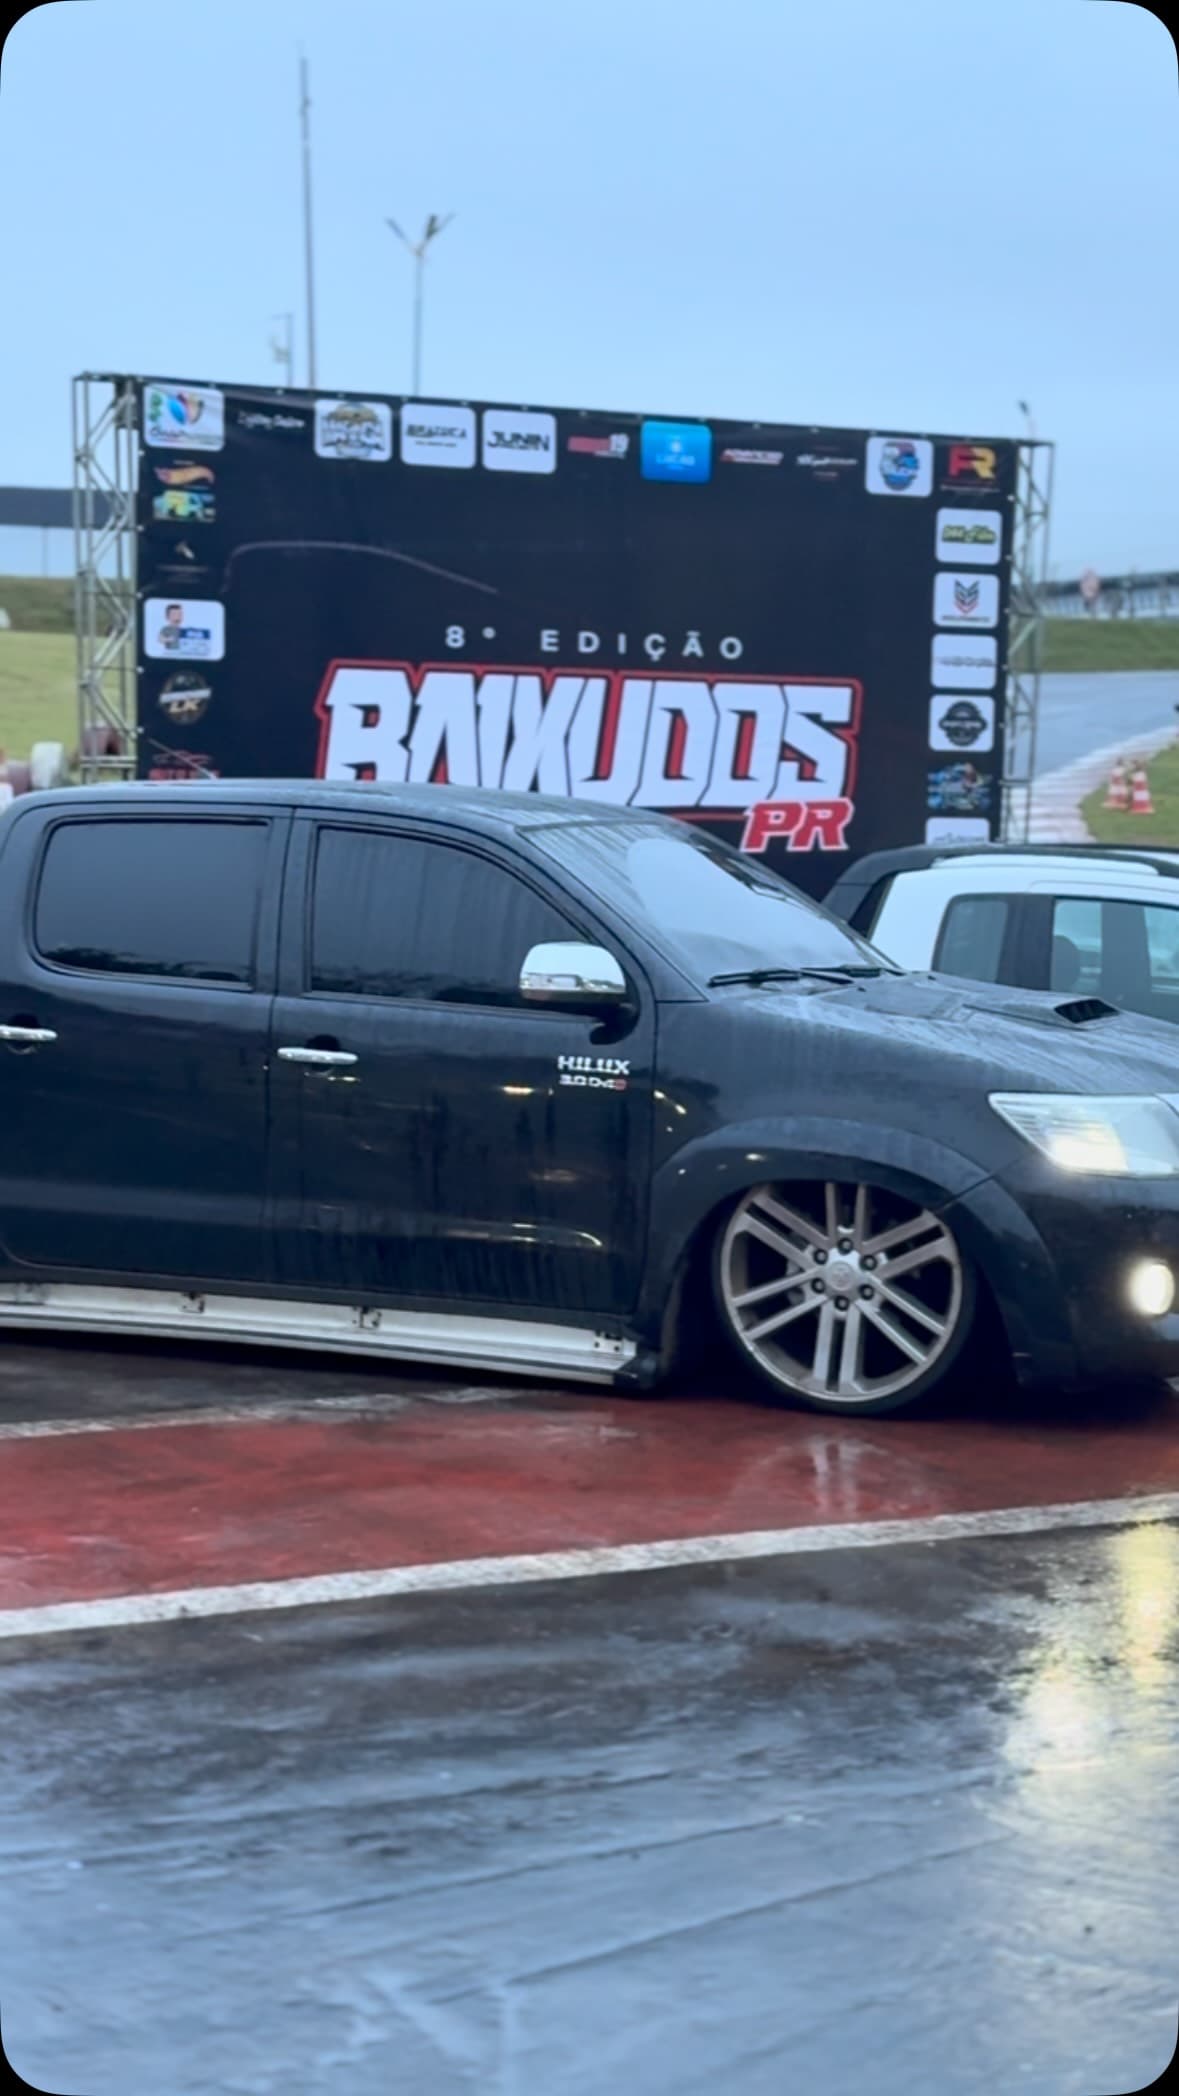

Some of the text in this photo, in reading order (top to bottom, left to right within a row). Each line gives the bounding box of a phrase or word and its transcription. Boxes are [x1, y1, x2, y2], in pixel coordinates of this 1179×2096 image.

[540, 631, 743, 660] EDIÇÃO
[321, 666, 856, 807] BAIXUDOS
[740, 799, 854, 852] PR
[557, 1055, 632, 1075] HILUX
